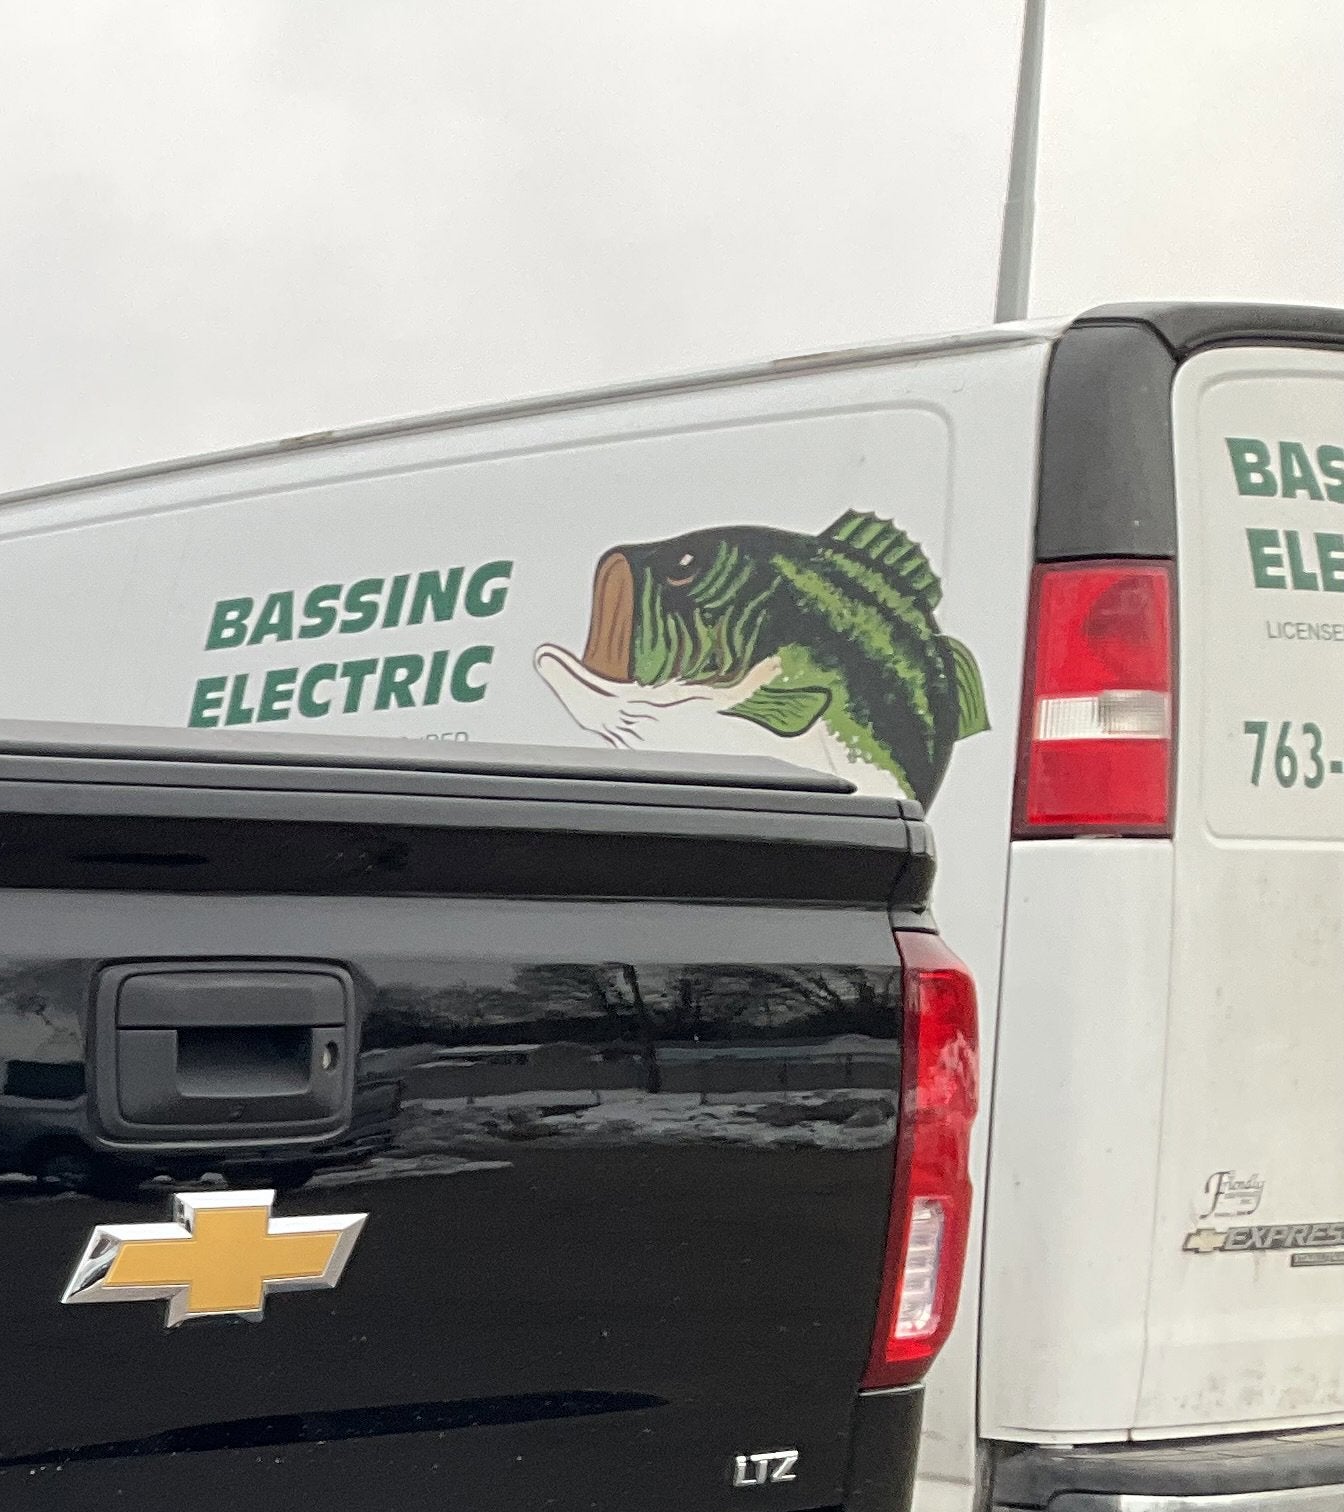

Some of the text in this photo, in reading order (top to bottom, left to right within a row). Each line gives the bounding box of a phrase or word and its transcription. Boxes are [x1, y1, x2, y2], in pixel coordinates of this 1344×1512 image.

[204, 560, 514, 651] BASSING
[187, 645, 495, 728] ELECTRIC
[1244, 720, 1344, 789] 763-
[733, 1450, 799, 1487] LTZ
